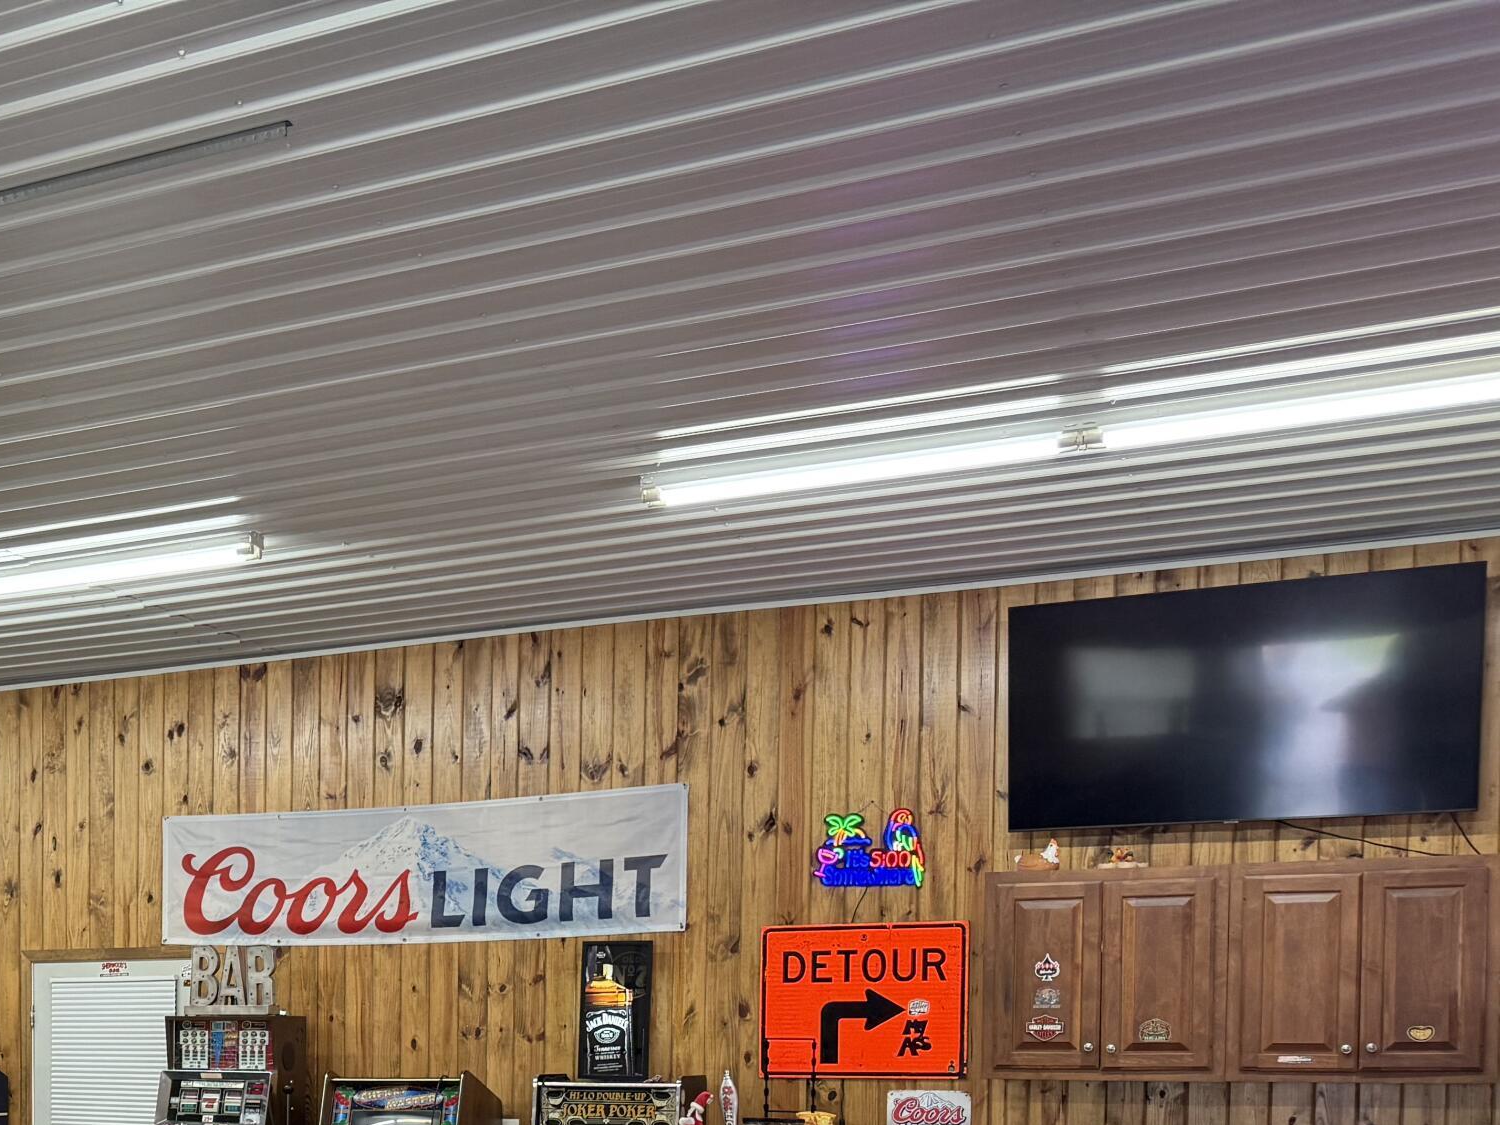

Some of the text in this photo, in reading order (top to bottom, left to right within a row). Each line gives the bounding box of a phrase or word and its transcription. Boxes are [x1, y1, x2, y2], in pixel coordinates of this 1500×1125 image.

[870, 850, 911, 868] 5:00
[181, 846, 669, 936] Coors LIGHT
[190, 945, 277, 1006] BAR
[782, 948, 947, 983] DETOUR
[585, 1016, 603, 1033] JACK
[569, 1091, 647, 1101] HI-LO DOUBLE-UP
[562, 1103, 658, 1119] JOKER POKER
[893, 1097, 967, 1125] Coors
